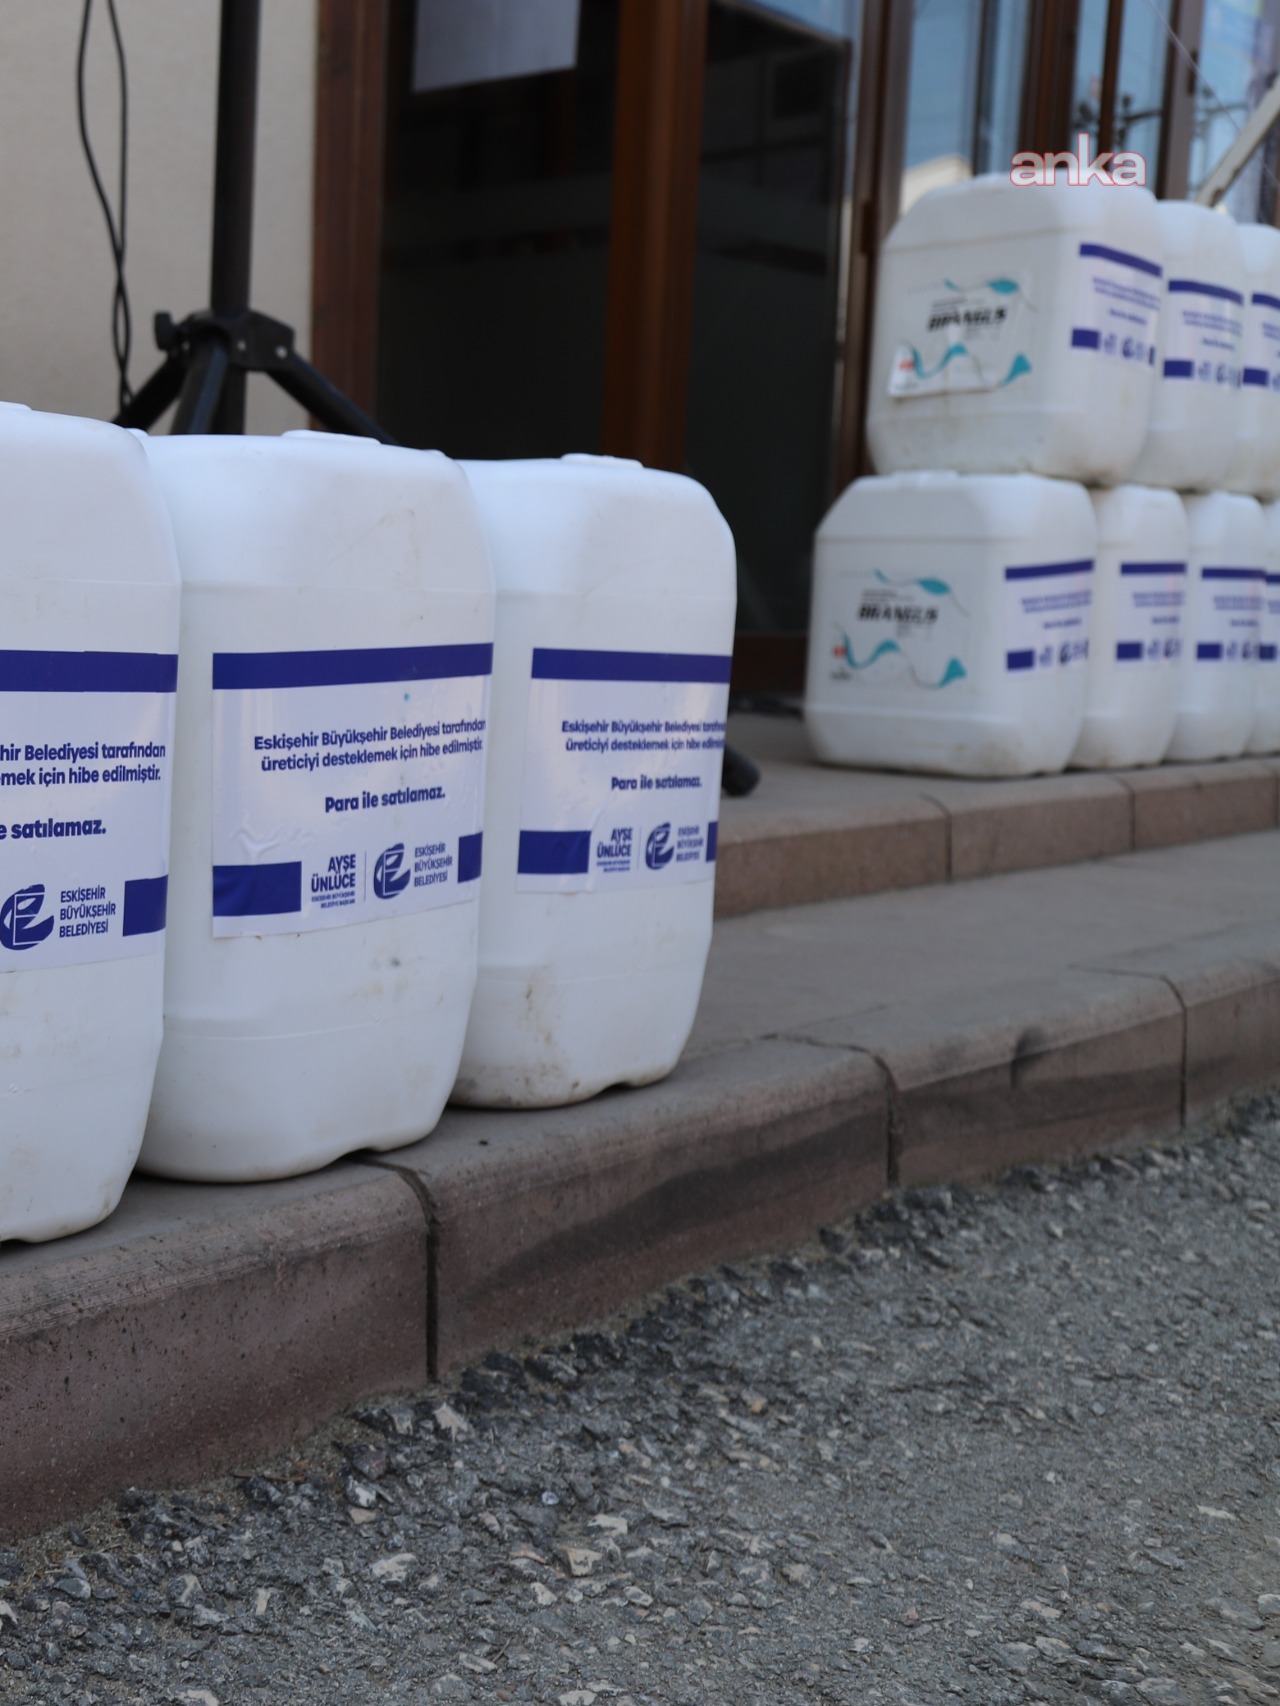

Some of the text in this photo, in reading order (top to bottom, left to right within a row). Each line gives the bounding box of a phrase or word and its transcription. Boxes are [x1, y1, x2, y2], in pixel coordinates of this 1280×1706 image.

[254, 732, 319, 751] Eskişehir
[322, 727, 388, 747] Büyükşehir
[390, 722, 440, 740] Belediyesi
[562, 720, 609, 734] Eskişehir
[611, 720, 662, 735] Büyükşehir
[25, 742, 98, 763] Belediyesi
[101, 742, 165, 759] tarafından
[261, 737, 483, 772] üreticiyi desteklemek için hibe edilmiştir.
[566, 738, 609, 754] üreticiyi
[611, 738, 669, 750] desteklemek
[39, 768, 66, 787] için
[68, 766, 99, 784] hibe
[102, 765, 161, 783] edilmiştir.
[612, 777, 637, 790] Para
[640, 774, 653, 789] ile
[325, 786, 446, 813] Para ile satılamaz.
[11, 818, 106, 839] satılamaz.
[415, 842, 446, 858] ESKİŞEHİR
[328, 854, 356, 875] AYŞE
[414, 856, 453, 872] BÜYÜKŞEHİR
[311, 872, 355, 892] ÜNLÜCE
[414, 871, 448, 887] BELEDİYESİ
[61, 887, 105, 903] ESKİŞEHİR
[60, 901, 116, 920] BÜYÜKŞEHİR
[60, 919, 108, 938] BELEDİYESİ
